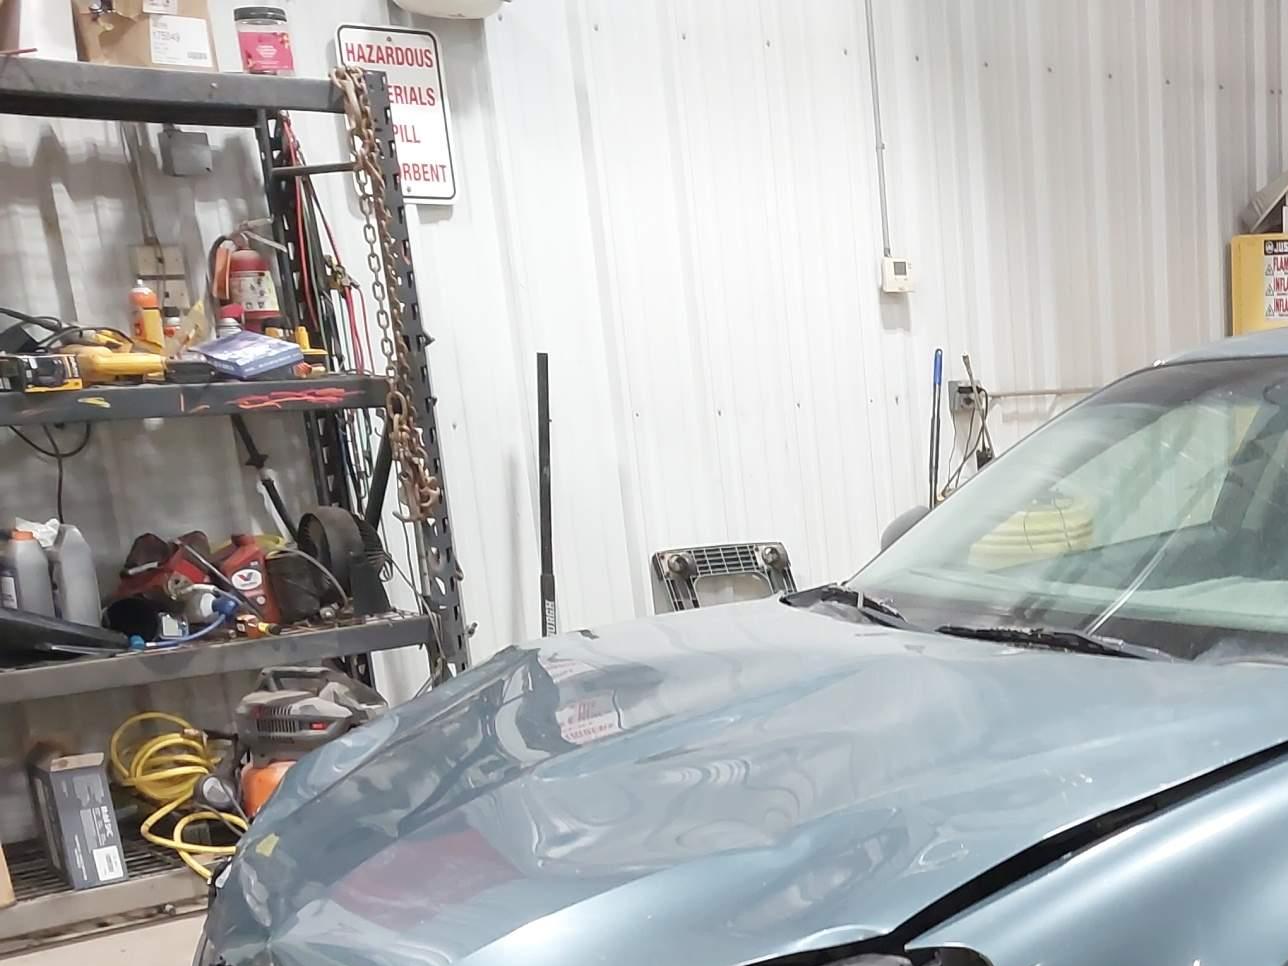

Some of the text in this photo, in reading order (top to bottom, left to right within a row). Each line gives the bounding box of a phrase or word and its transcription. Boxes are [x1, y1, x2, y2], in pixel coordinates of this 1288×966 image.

[345, 42, 434, 69] HAZARDOUS
[386, 84, 436, 107] ERIALS
[392, 123, 421, 144] PILL
[400, 162, 447, 183] RBENT
